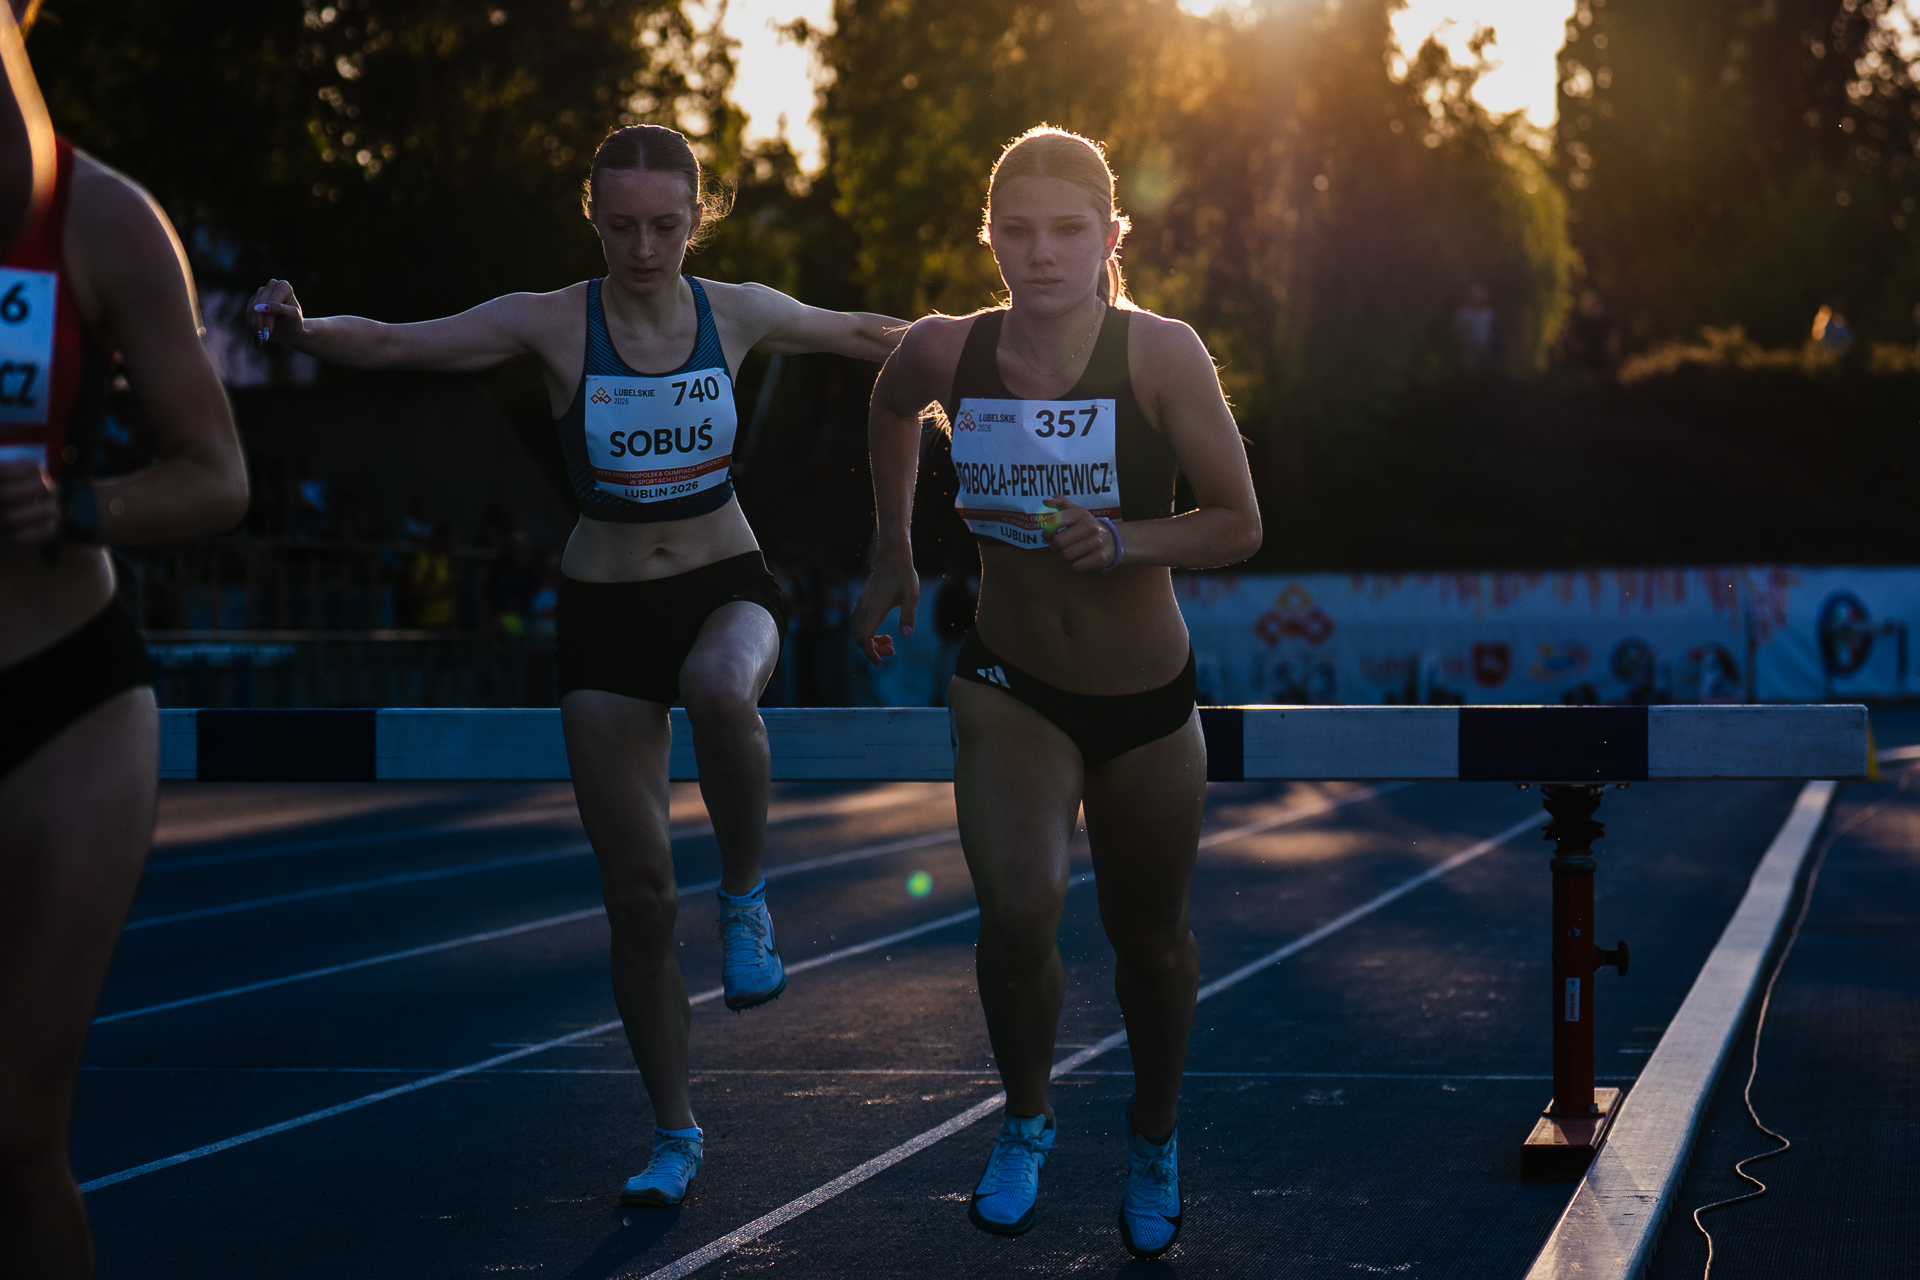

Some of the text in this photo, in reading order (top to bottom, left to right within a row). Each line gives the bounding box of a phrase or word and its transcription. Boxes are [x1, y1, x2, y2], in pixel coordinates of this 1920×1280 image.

[613, 388, 656, 397] LUBELSKIE
[671, 376, 720, 406] 740
[978, 413, 1016, 423] LUBELSKIE
[1034, 408, 1098, 438] 357
[977, 424, 992, 432] 2026
[609, 417, 713, 458] SOBUŚ
[637, 477, 672, 485] SPORTACH
[672, 473, 696, 482] LETNICH
[664, 467, 696, 477] OLIMPIADA
[955, 461, 1111, 496] TOBOŁA-PERTKIEWICZ
[624, 481, 699, 499] LUBLIN 2026
[1000, 526, 1037, 544] LUBLIN
